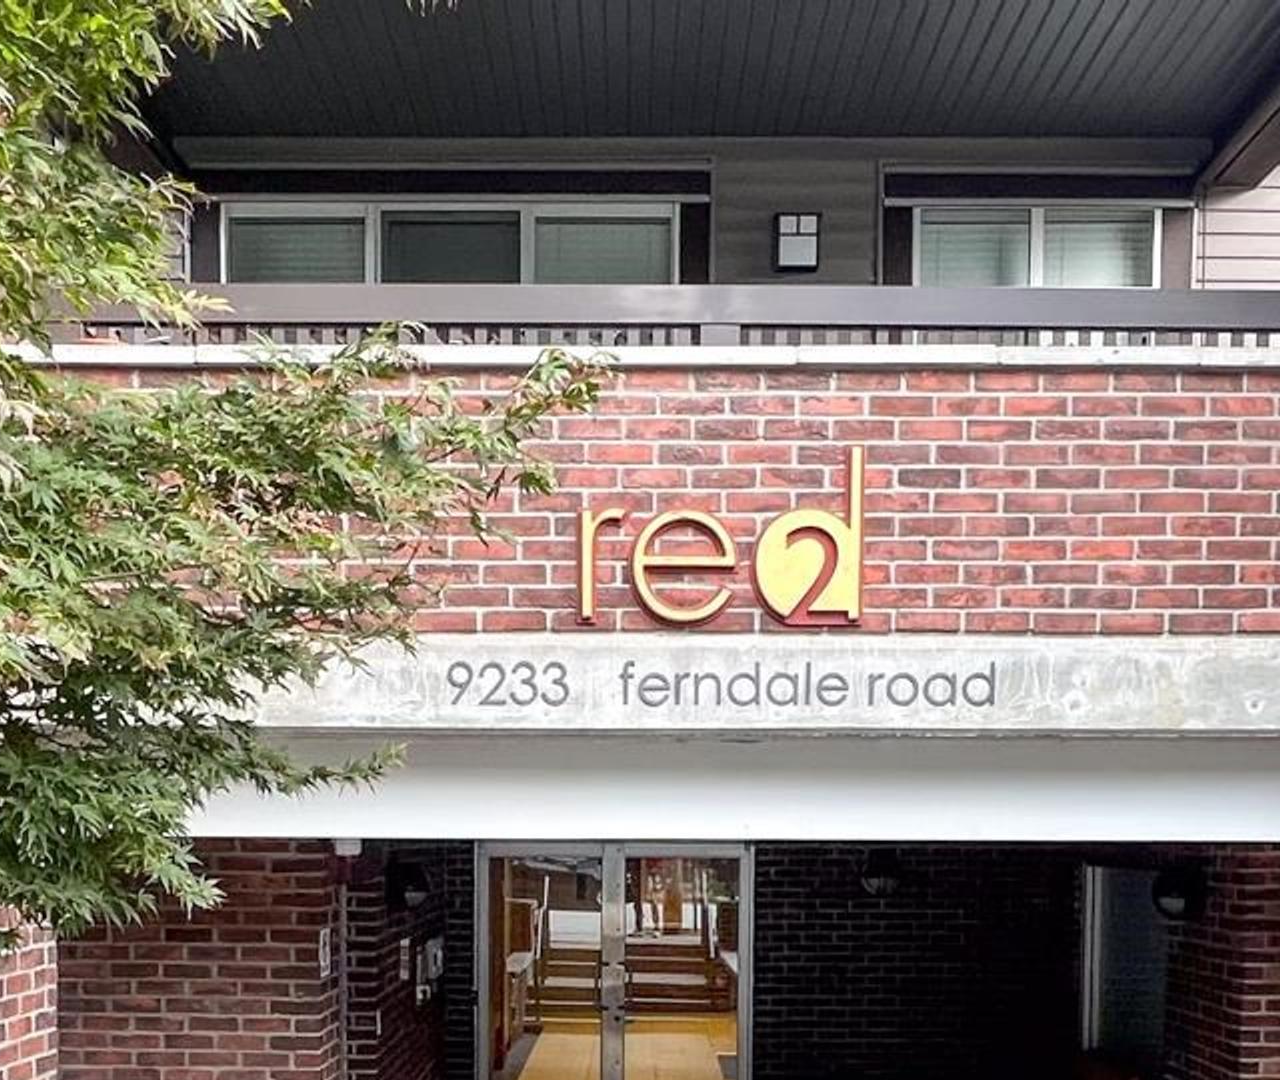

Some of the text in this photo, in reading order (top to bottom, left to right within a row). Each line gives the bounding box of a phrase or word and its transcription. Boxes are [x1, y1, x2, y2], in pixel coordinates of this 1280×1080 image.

[446, 660, 996, 708] 9233 ferndale road
